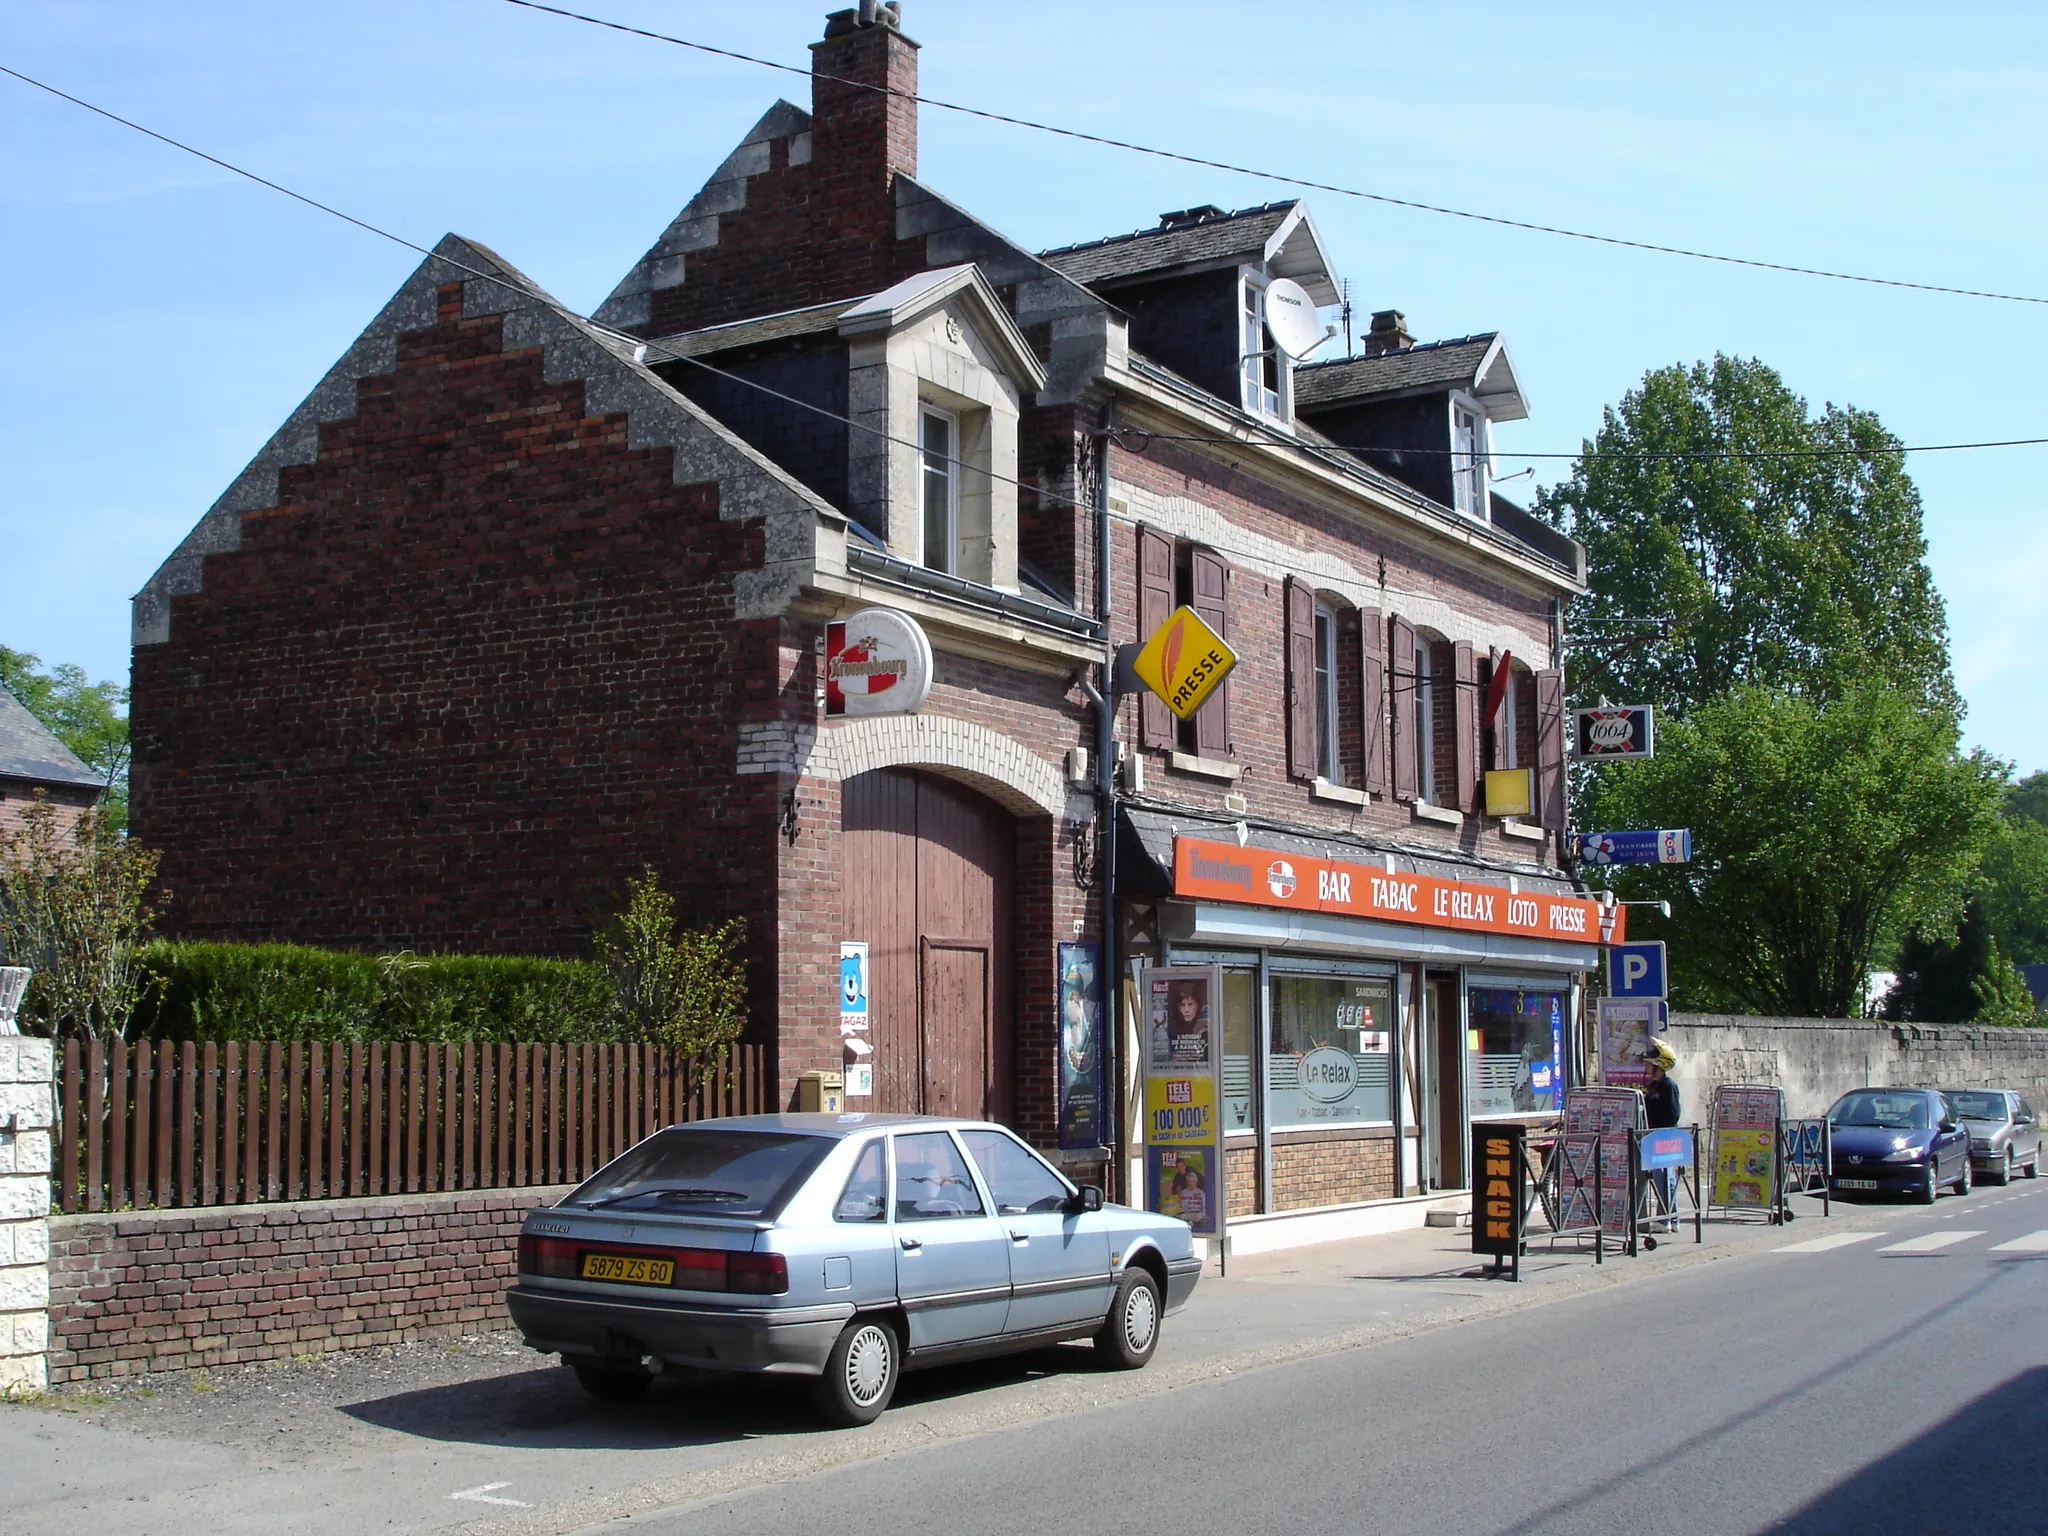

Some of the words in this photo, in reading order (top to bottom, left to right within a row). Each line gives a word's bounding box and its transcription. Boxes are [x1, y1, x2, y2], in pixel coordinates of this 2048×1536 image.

[829, 656, 907, 681] Kronenbourg
[1173, 650, 1224, 710] PRESSE
[1592, 721, 1629, 740] 1664
[1318, 869, 1352, 903] BAR
[1370, 877, 1418, 912] TABAC
[1433, 887, 1449, 917] LE
[1451, 889, 1495, 922] RELAX
[1507, 898, 1538, 928] LOTO
[1549, 904, 1586, 933] PRESSE
[1623, 954, 1648, 990] P
[1306, 1064, 1318, 1083] Le
[1321, 1063, 1350, 1083] Relax
[1168, 1082, 1190, 1094] TÉLÉ
[1153, 1109, 1174, 1130] 100
[1178, 1106, 1201, 1128] 000
[1203, 1105, 1209, 1122] €
[1486, 1138, 1512, 1238] SNACK
[589, 1258, 624, 1277] 5879
[627, 1261, 645, 1279] ZS
[649, 1263, 668, 1281] 60
